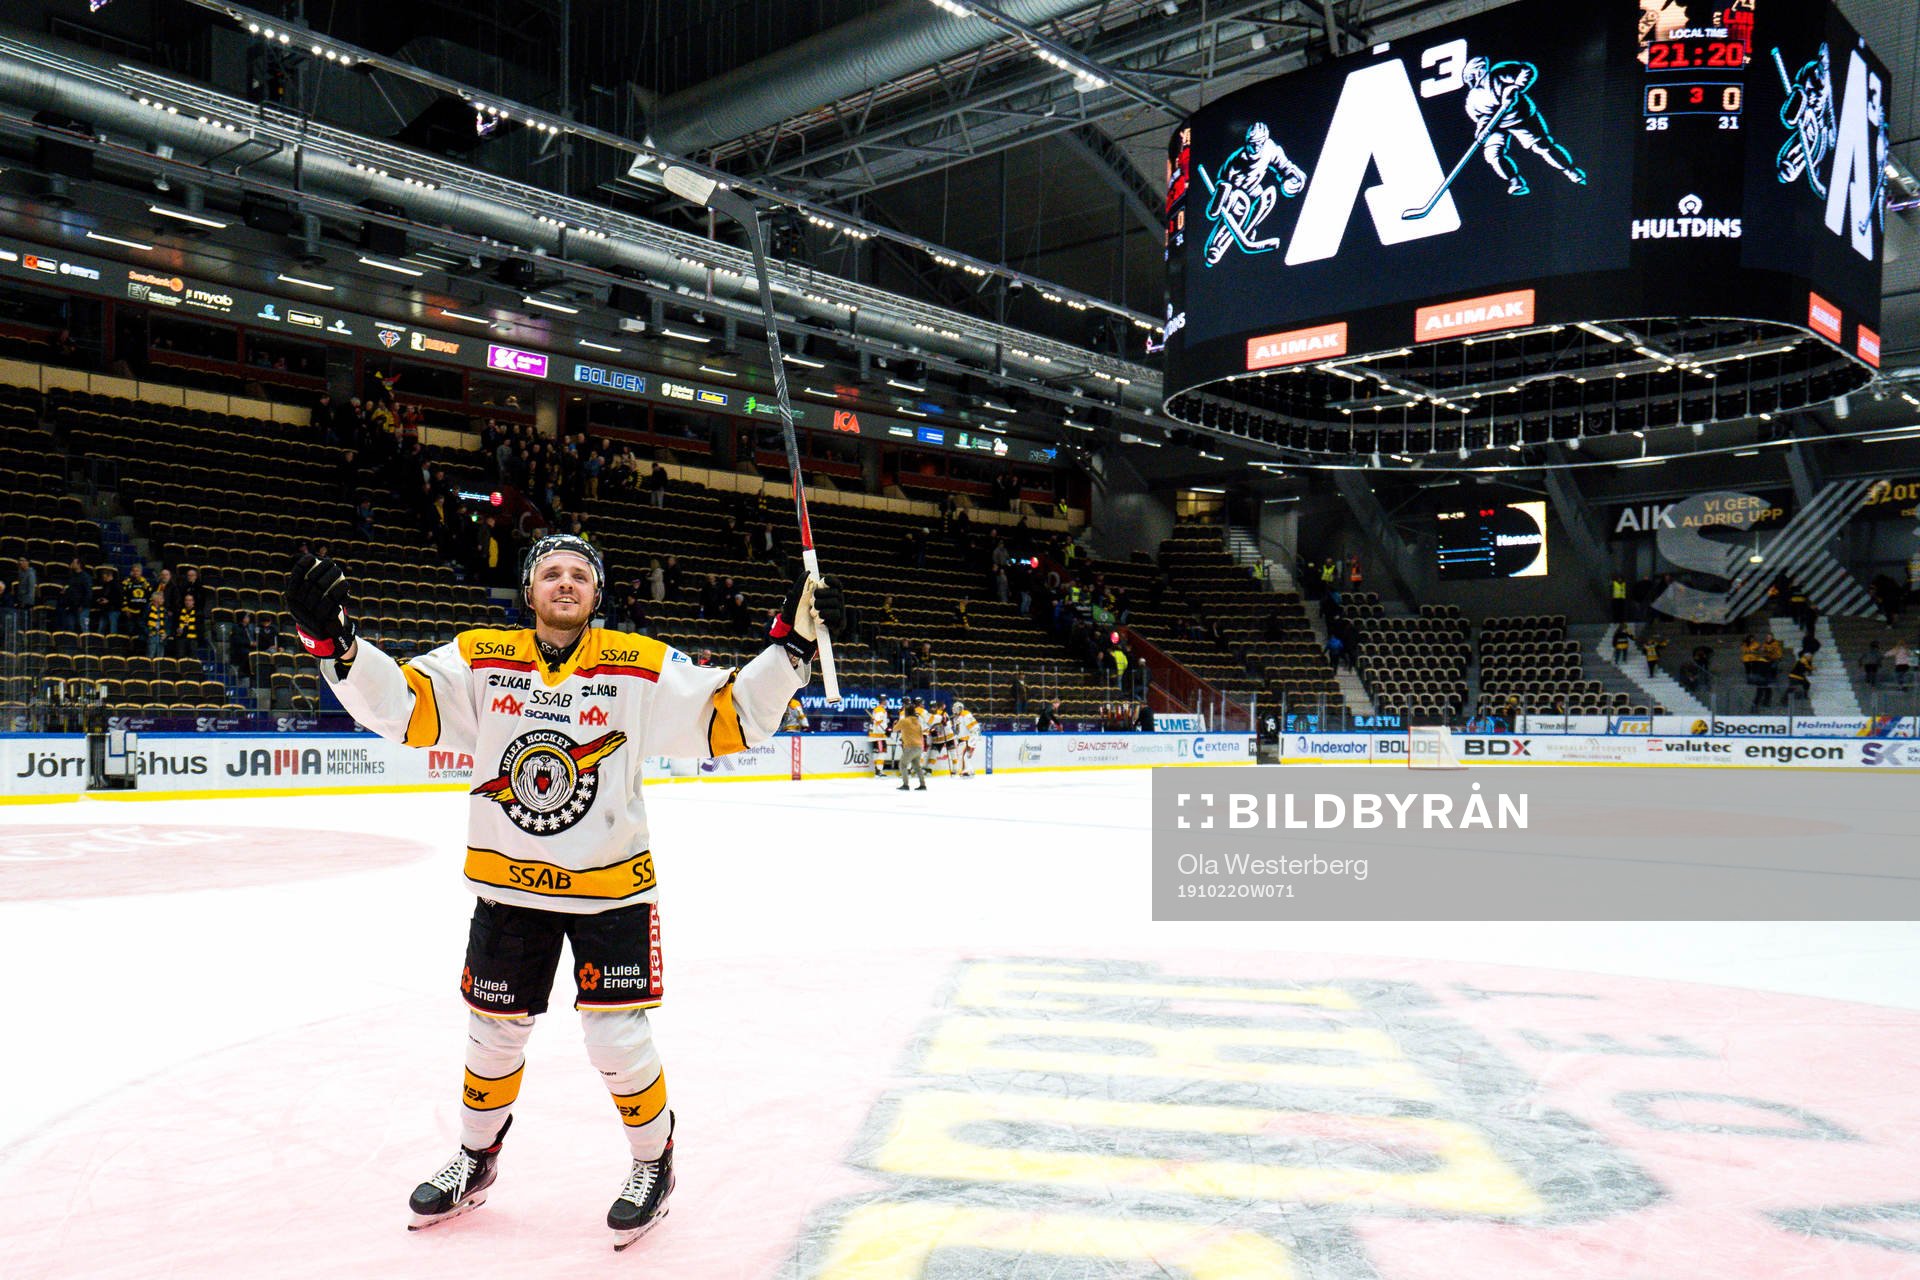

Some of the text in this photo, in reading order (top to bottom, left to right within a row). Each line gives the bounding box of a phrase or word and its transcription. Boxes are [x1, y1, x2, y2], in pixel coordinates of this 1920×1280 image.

[1669, 28, 1728, 39] LOCAL TIME
[1647, 42, 1744, 68] 21:20
[1647, 87, 1740, 112] 0 3 0
[1646, 116, 1739, 131] 35 31
[1631, 218, 1742, 239] HULTDINS
[1424, 301, 1523, 331] ALIMAK
[1256, 333, 1338, 359] ALIMAK
[579, 366, 646, 393] BOLIDEN
[833, 410, 860, 433] ICA
[1705, 497, 1760, 512] VI GER
[1615, 504, 1676, 533] AIK
[1682, 509, 1784, 527] ALDRIG UPP
[475, 642, 516, 657] SSAB
[599, 649, 640, 662] SSAB
[500, 675, 531, 691] LKAB
[590, 683, 617, 697] LKAB
[491, 693, 525, 717] MAX
[530, 689, 573, 708] SSAB
[524, 709, 572, 724] SCANIA
[579, 705, 609, 727] MAX
[1355, 715, 1400, 727] BASTU
[1713, 721, 1786, 736] Specma
[1797, 721, 1869, 729] Holmlunds
[526, 732, 572, 750] HOCKEY
[1077, 739, 1129, 752] SANDSTRÖM
[1205, 741, 1240, 752] extena
[1311, 741, 1367, 753] Indexator
[1464, 739, 1532, 756] BDX
[1665, 740, 1731, 753] valutec
[327, 748, 367, 761] MINING
[841, 740, 869, 765] Diös
[1745, 745, 1844, 762] engcon
[226, 749, 321, 777] JAMA
[327, 761, 384, 775] MACHINES
[509, 864, 572, 890] SSAB
[603, 963, 641, 977] Luleå
[474, 976, 509, 992] Luleå
[603, 977, 647, 989] Energi
[473, 987, 515, 1004] Energi
